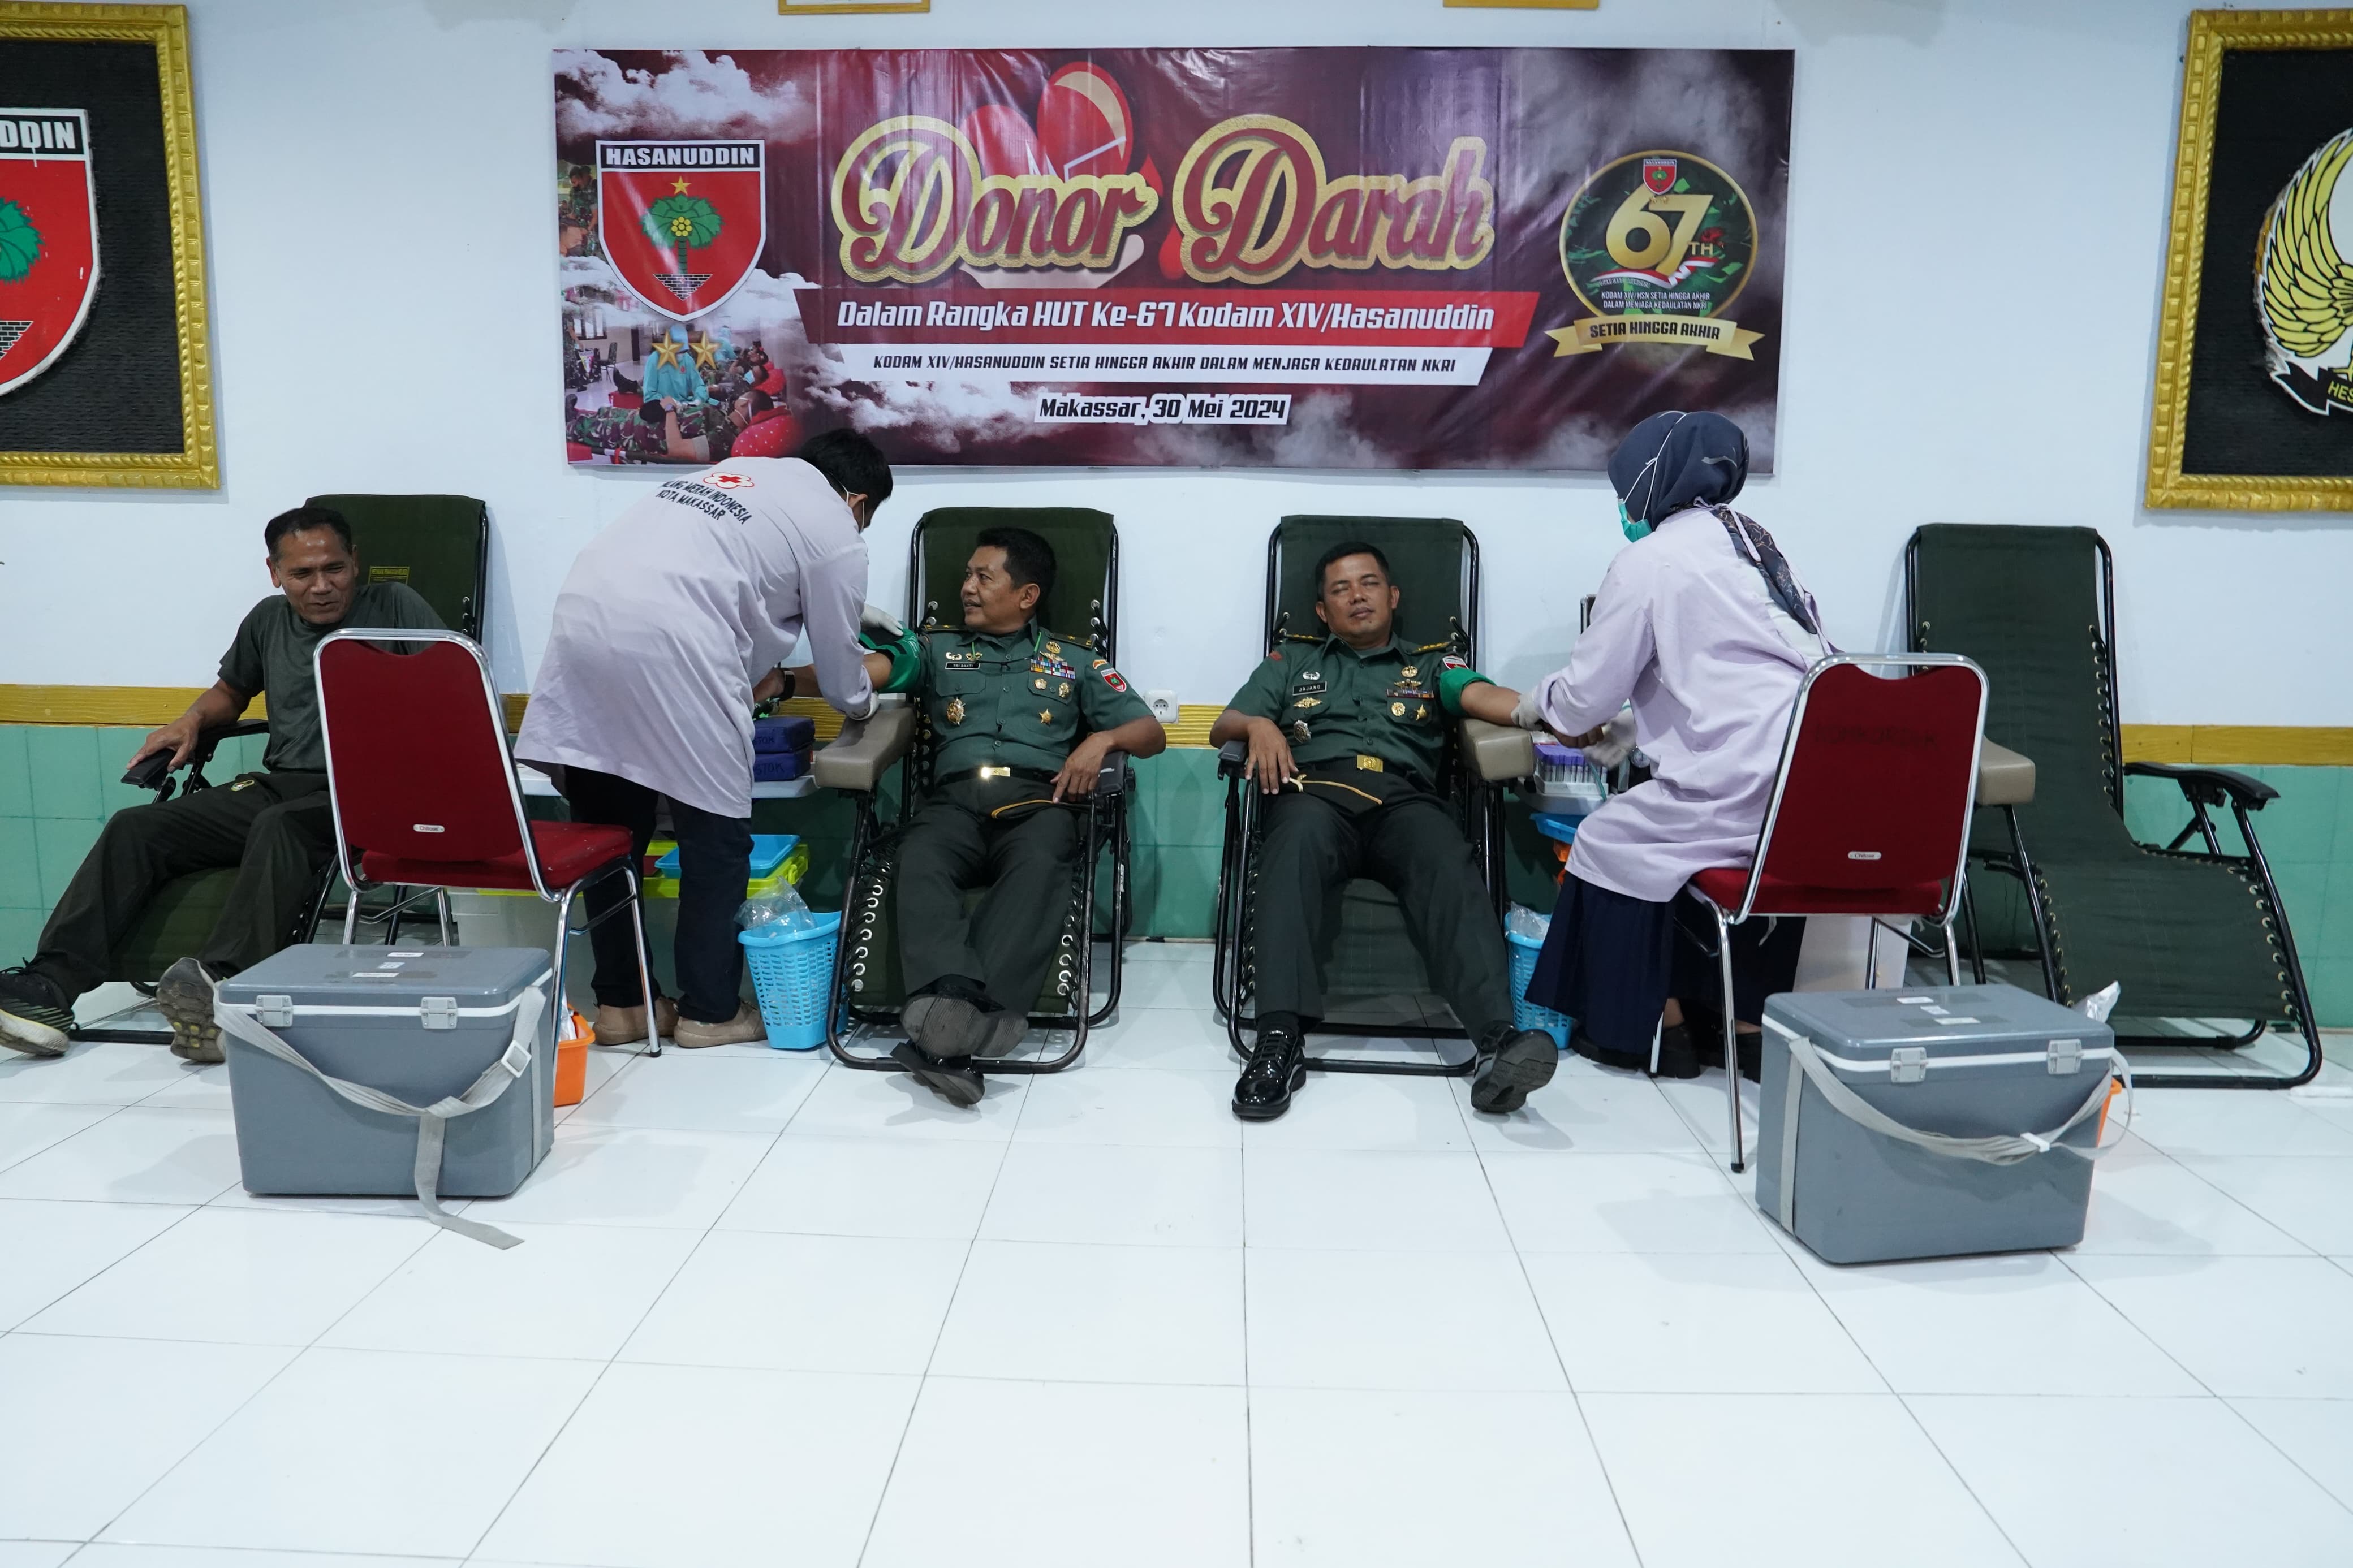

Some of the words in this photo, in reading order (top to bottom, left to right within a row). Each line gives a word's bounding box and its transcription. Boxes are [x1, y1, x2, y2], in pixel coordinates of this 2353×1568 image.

[606, 147, 755, 165] HASANUDDIN
[831, 115, 1158, 283] Donor
[1173, 114, 1494, 284] Darah
[1624, 291, 1650, 300] XIV/HSN
[837, 301, 923, 326] Dalam
[926, 301, 1027, 331] Rangka
[1032, 301, 1088, 327] HUT
[1091, 301, 1175, 327] Ke-67
[1178, 302, 1275, 329] Kodam
[1278, 303, 1495, 333] XIV/Hasanuddin
[1589, 322, 1627, 338] SETIA
[1629, 321, 1678, 336] HINGGA
[1680, 323, 1721, 340] AKHIR
[874, 355, 923, 369] KODAM
[926, 356, 1045, 370] XIV/HASANUDDIN
[1050, 356, 1091, 369] SETIA
[1094, 356, 1148, 369] HINGGA
[1152, 357, 1196, 369] AKHIR
[1200, 357, 1248, 370] DALAM
[1253, 358, 1320, 371] MENJAGA
[1325, 358, 1417, 372] KEDAULATAN
[1421, 360, 1456, 372] NKRI
[1039, 398, 1146, 420] Makassar,
[1153, 398, 1181, 418] 30
[1187, 398, 1223, 419] Mei
[1230, 399, 1287, 419] 2024
[677, 494, 726, 521] MAKASSAR
[708, 490, 753, 525] INDONESIA
